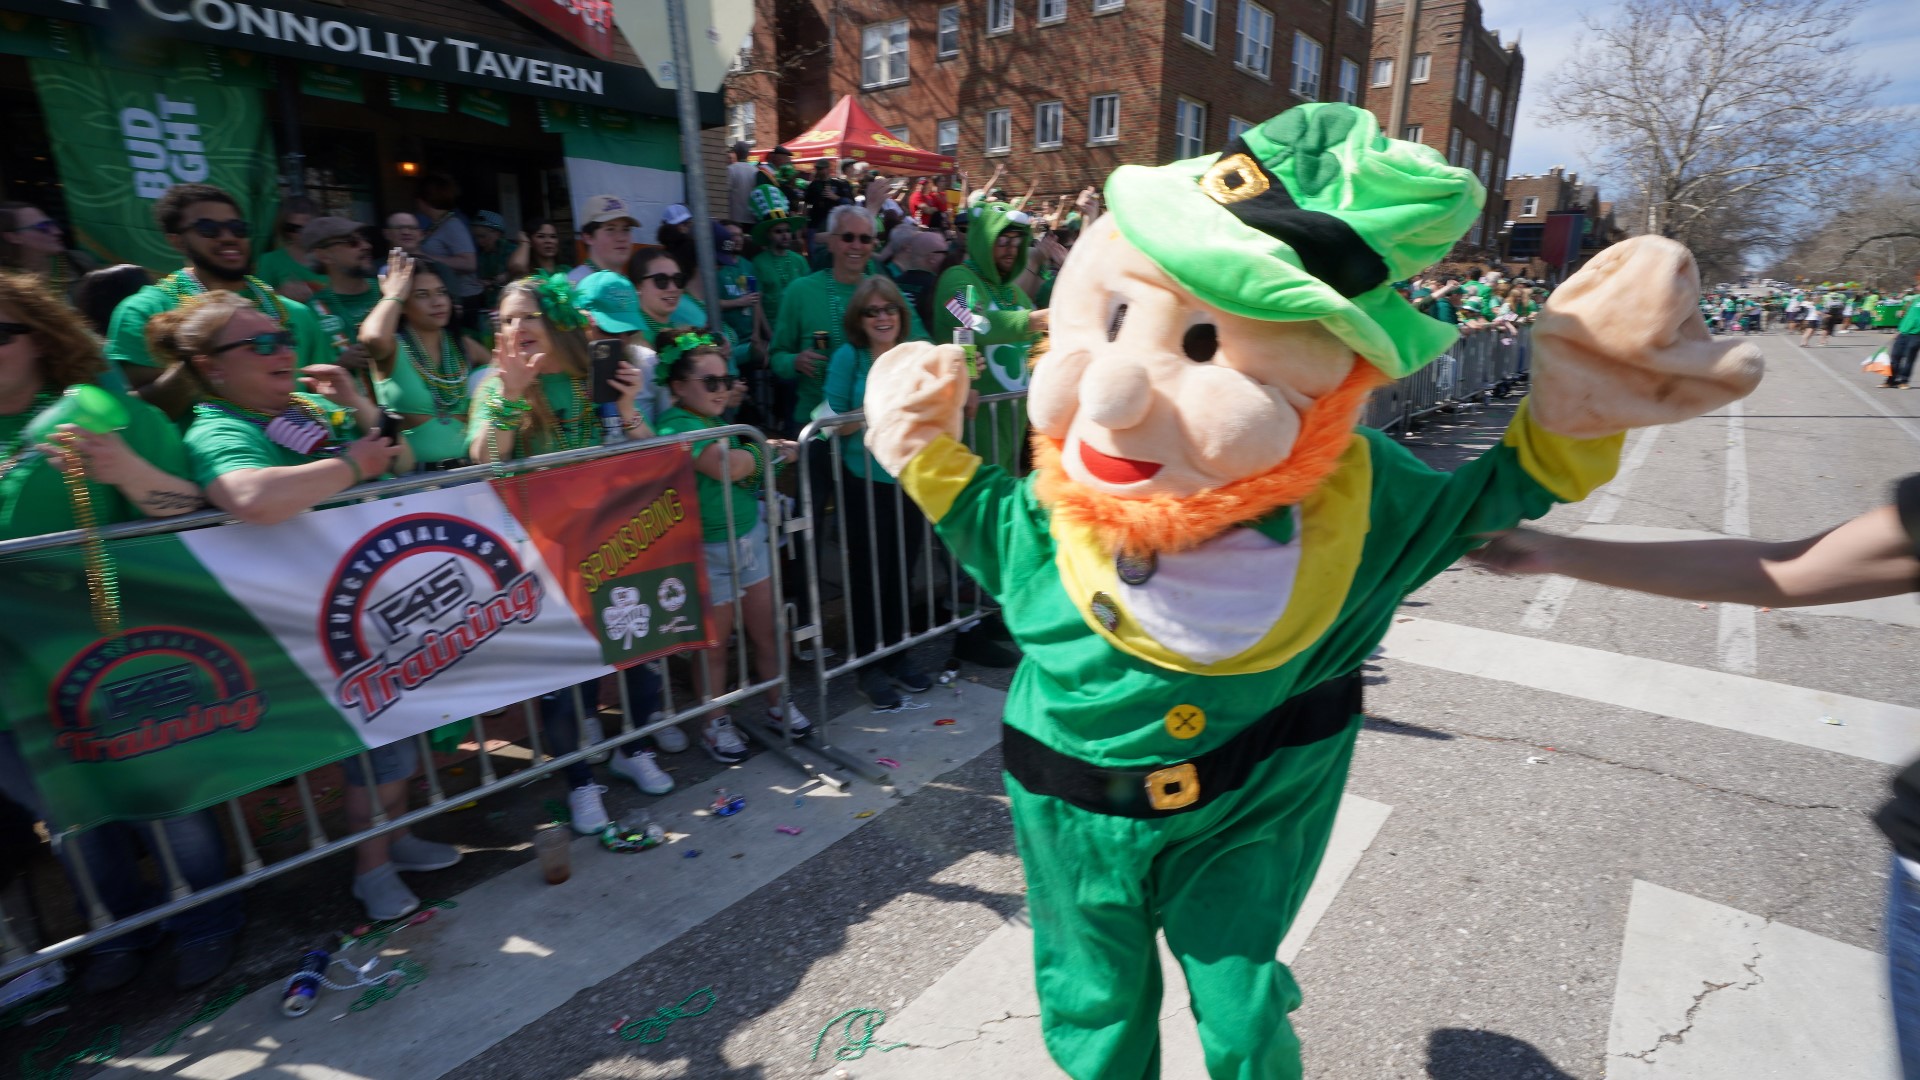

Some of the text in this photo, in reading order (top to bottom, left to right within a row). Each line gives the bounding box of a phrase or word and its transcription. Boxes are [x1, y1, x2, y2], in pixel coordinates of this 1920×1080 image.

[444, 37, 604, 95] TAVERN
[119, 107, 174, 199] BUD
[154, 93, 209, 183] GHT
[330, 526, 495, 640] FUNCTIONAL 45
[579, 488, 684, 593] SPONSORING
[337, 574, 543, 719] Training
[370, 560, 470, 642] F45
[56, 692, 266, 762] Training
